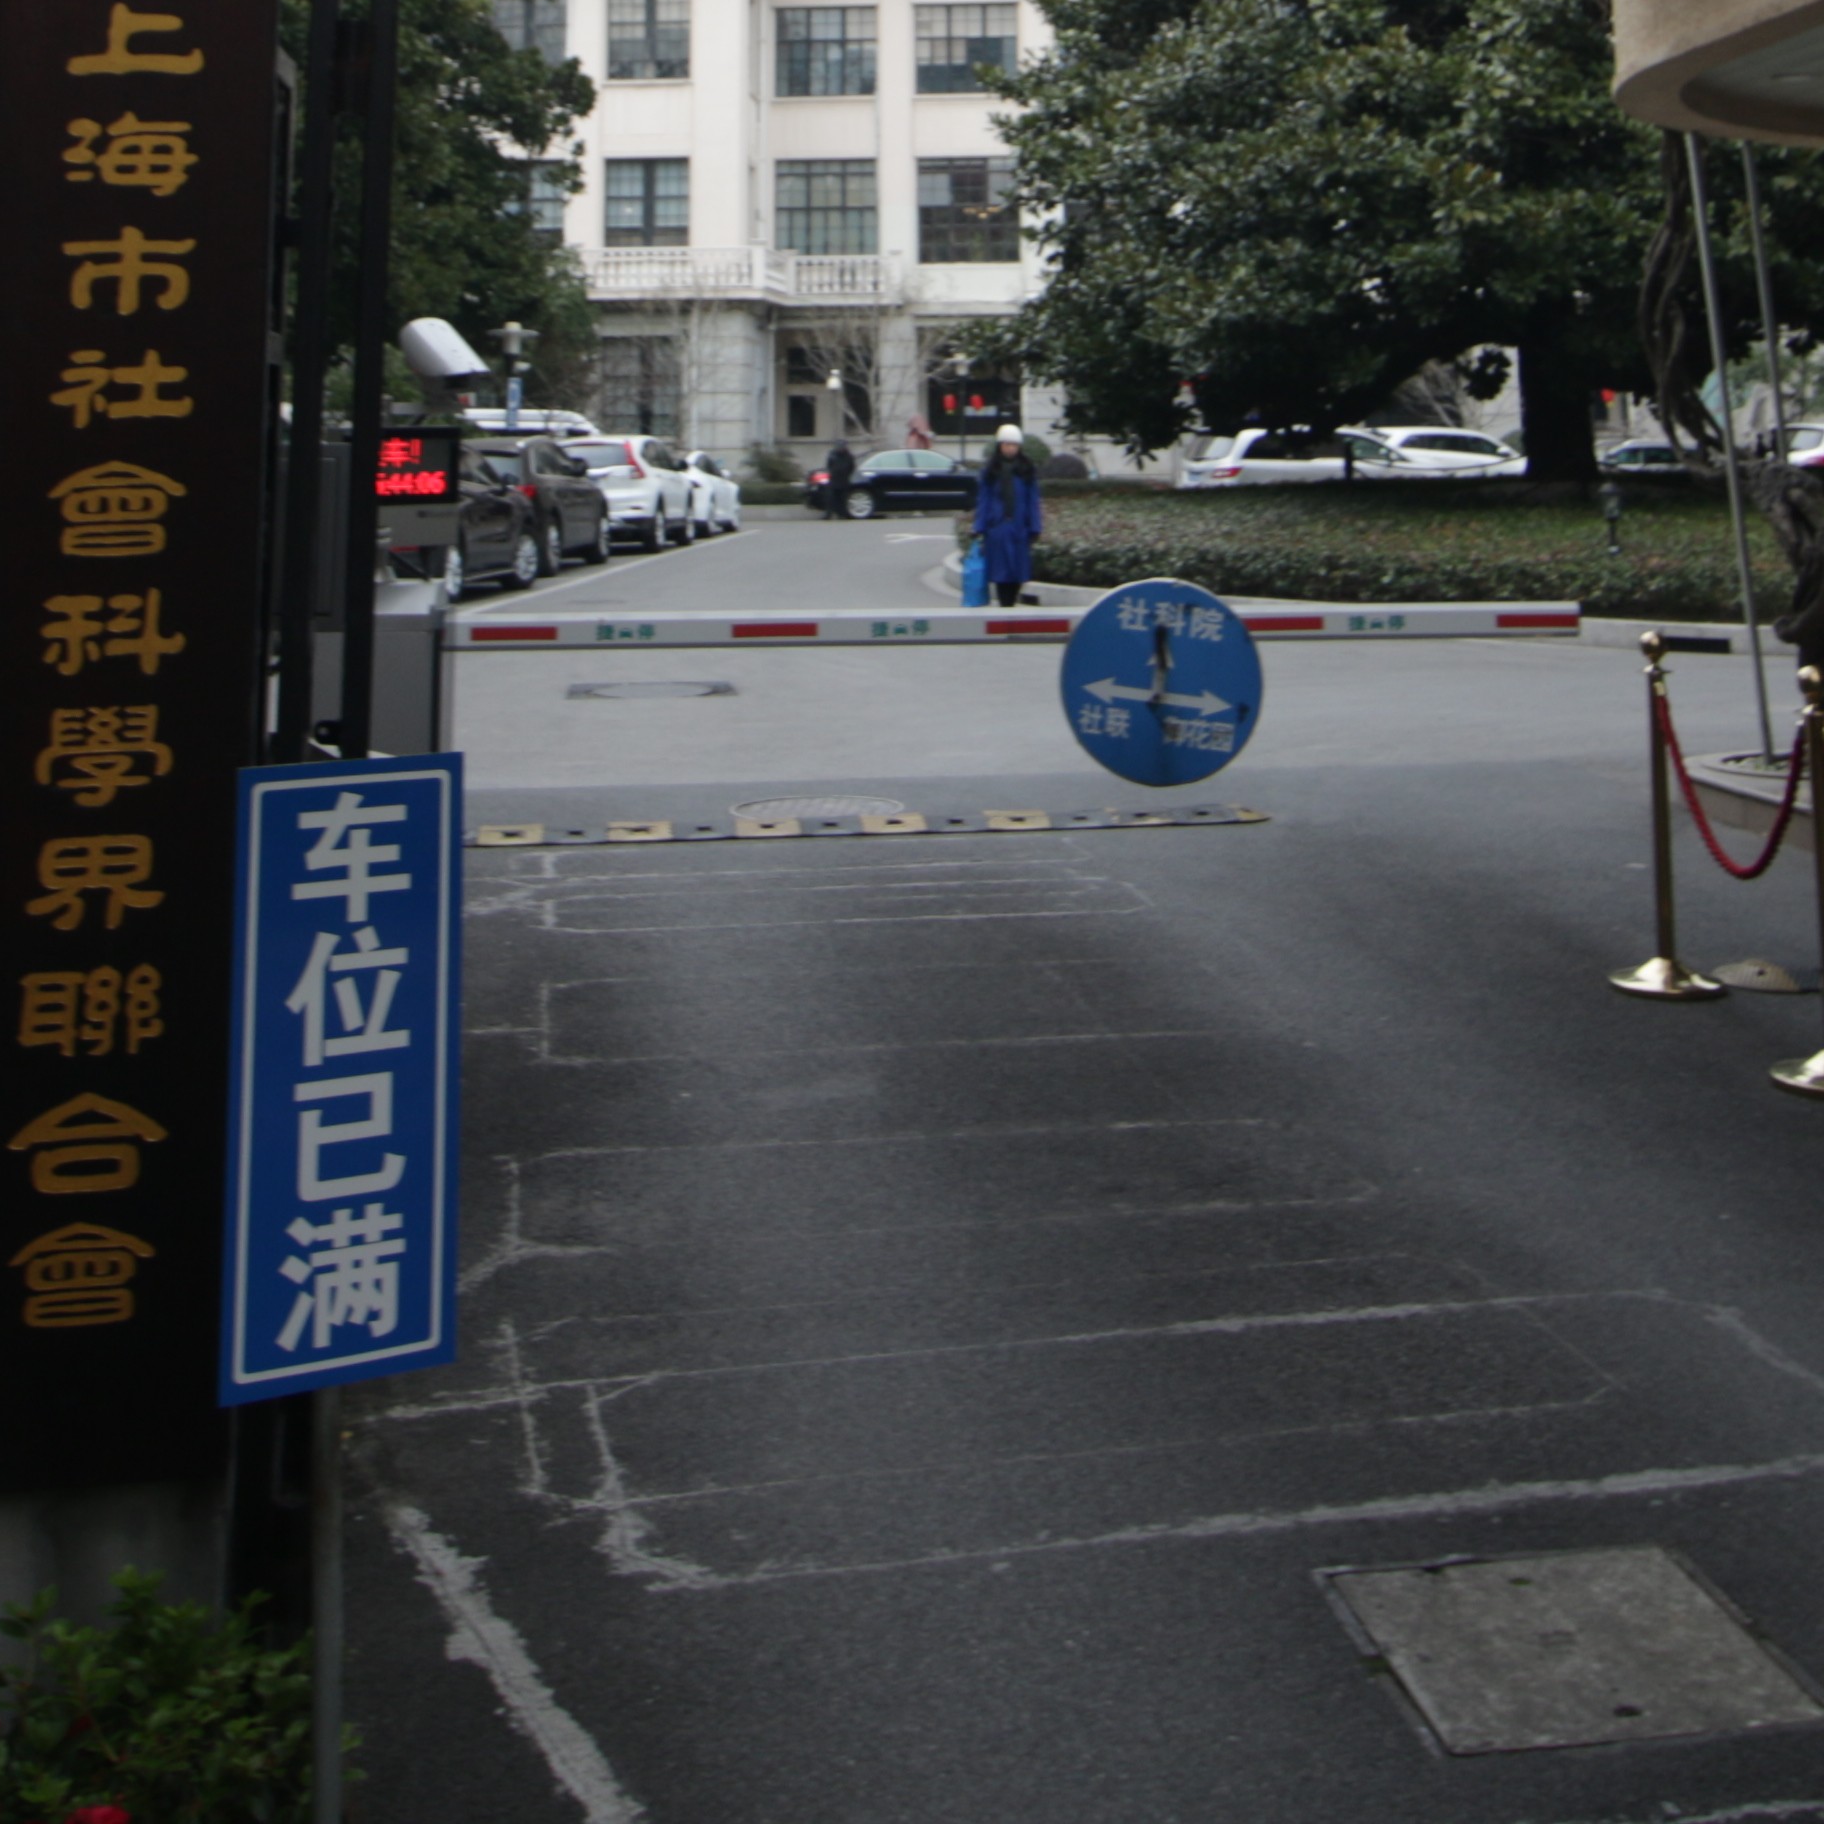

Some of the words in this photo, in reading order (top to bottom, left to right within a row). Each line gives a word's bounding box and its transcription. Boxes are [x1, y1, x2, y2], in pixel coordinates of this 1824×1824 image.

[7, 2, 205, 1329] 上海市社會科學界聯合會
[1078, 704, 1130, 739] 社联
[1116, 596, 1224, 642] 社科院
[274, 792, 413, 1353] 车位已满
